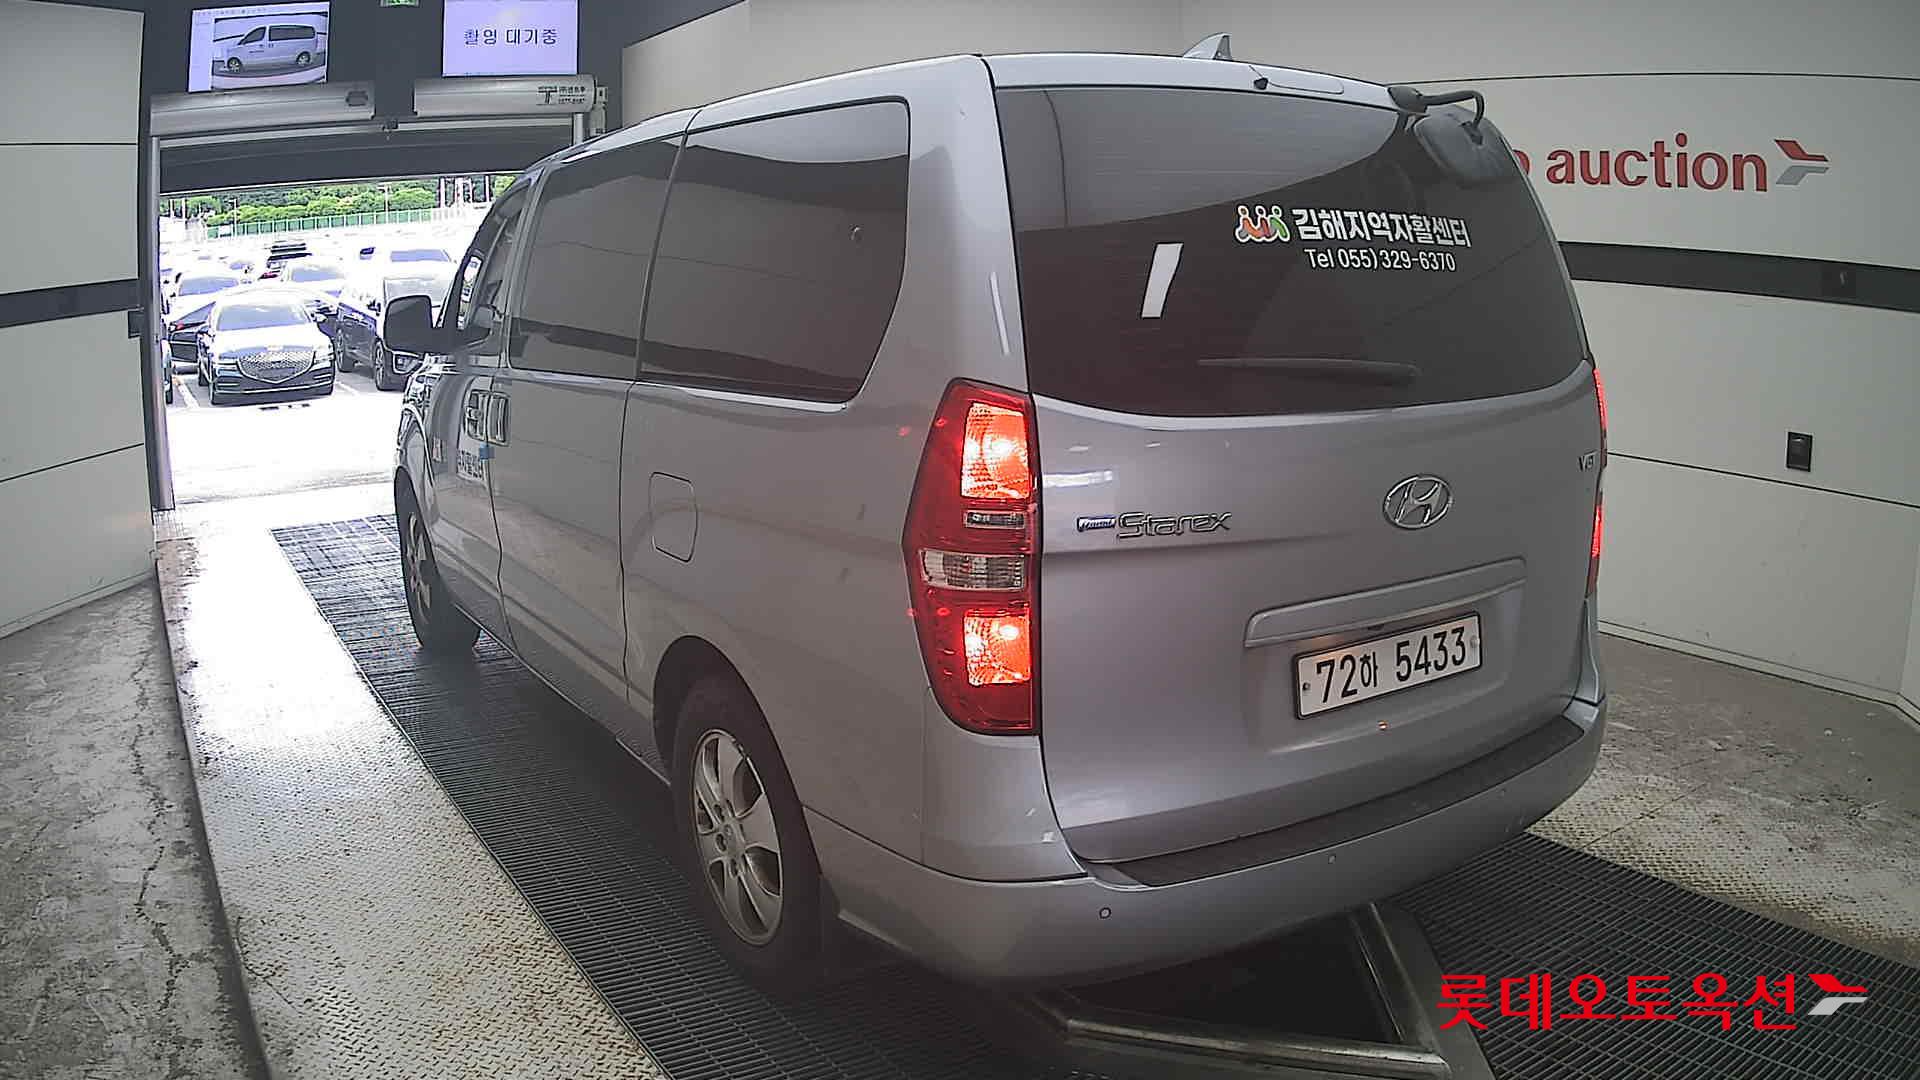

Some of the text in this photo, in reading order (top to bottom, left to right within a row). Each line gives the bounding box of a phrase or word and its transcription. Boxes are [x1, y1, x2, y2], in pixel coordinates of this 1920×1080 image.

[506, 28, 558, 46] 대기중
[1546, 132, 1768, 192] auction
[1292, 207, 1472, 248] 김해지역자활센터
[1304, 248, 1334, 269] Tel
[1118, 511, 1232, 539] Starex
[1316, 626, 1467, 703] 72하 5433
